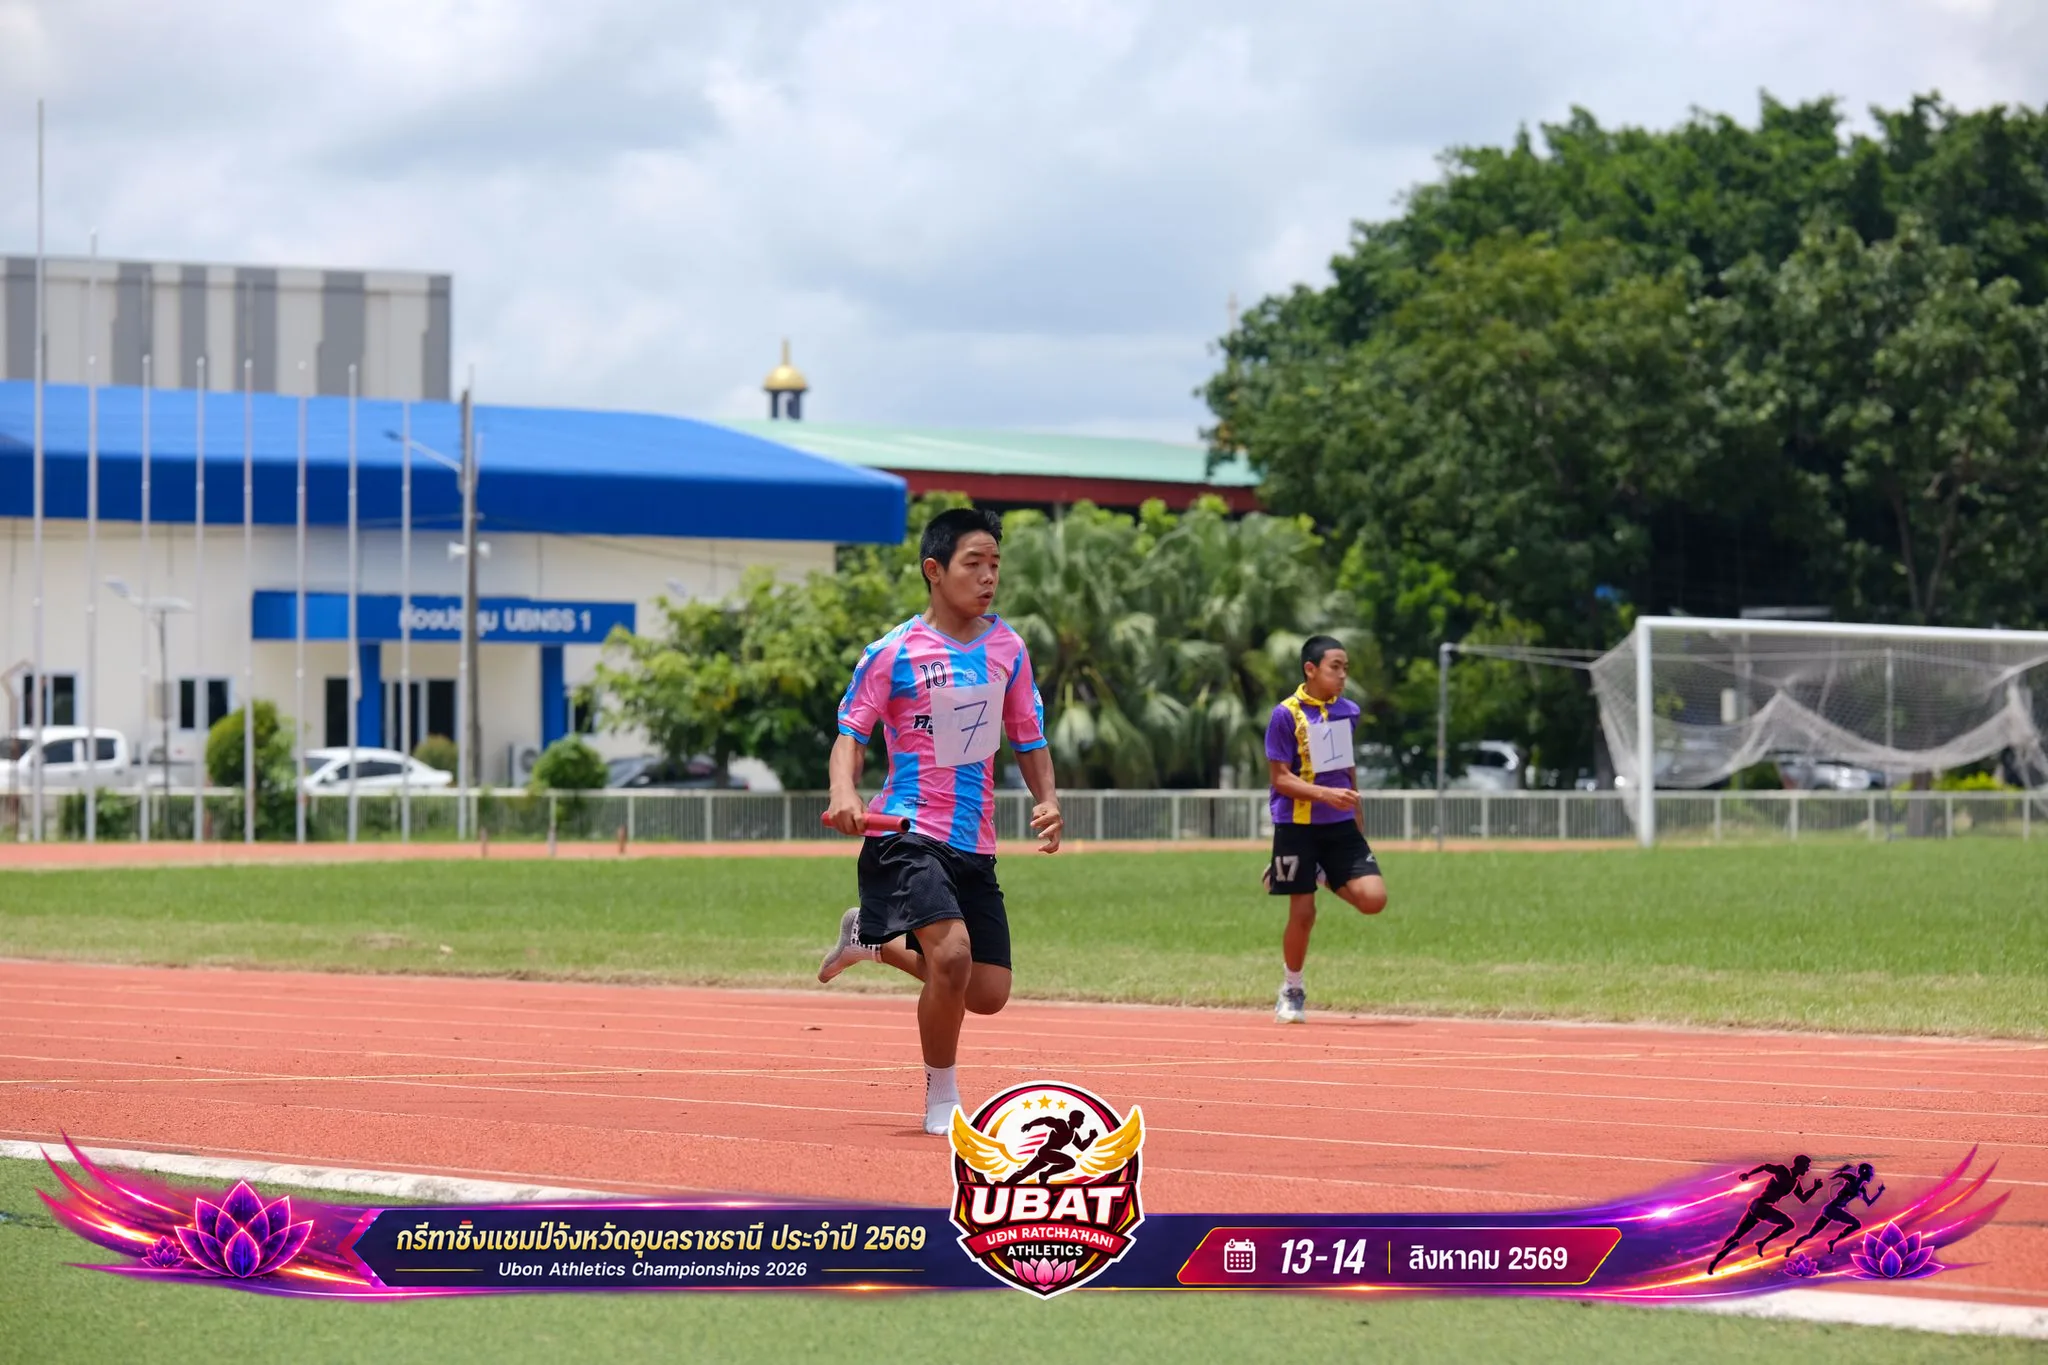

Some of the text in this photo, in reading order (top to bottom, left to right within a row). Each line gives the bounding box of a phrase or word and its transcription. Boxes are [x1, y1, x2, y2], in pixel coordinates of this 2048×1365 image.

[580, 610, 591, 633] 1
[919, 661, 947, 688] 10
[954, 700, 988, 754] 7
[1323, 728, 1343, 763] 1
[1275, 855, 1300, 882] 17
